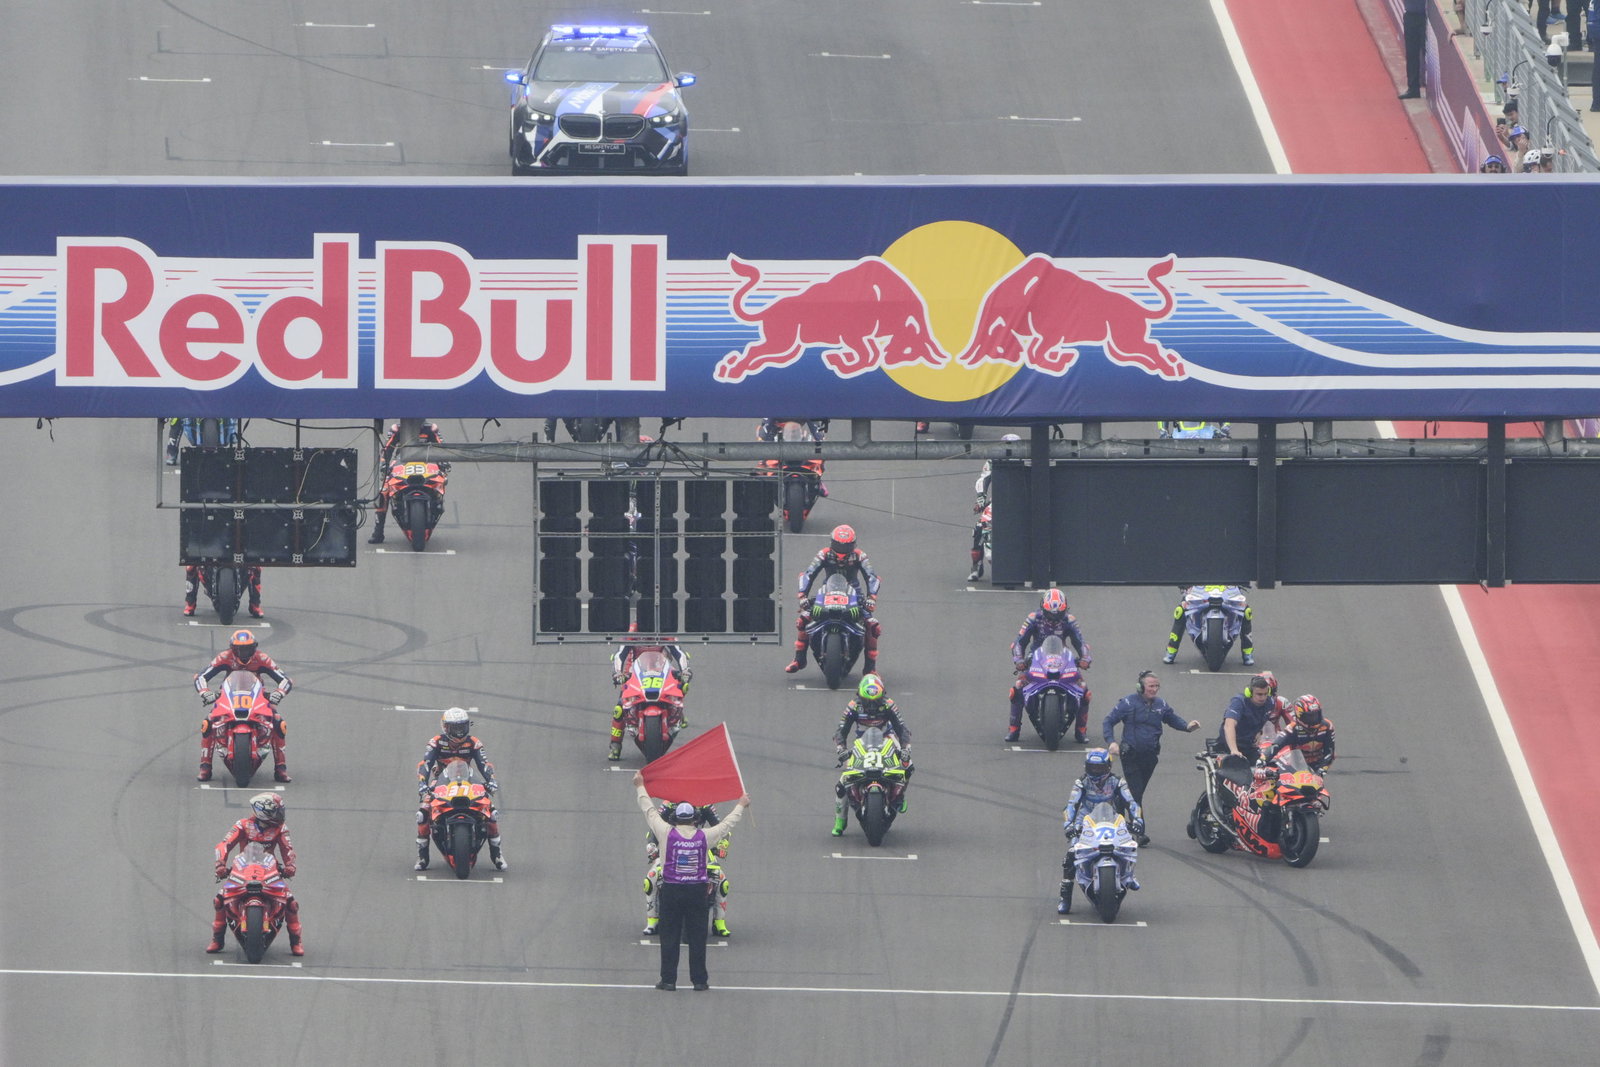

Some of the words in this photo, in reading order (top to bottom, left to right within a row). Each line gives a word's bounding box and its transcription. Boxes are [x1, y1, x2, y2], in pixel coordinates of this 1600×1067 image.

[63, 238, 352, 384] Red
[380, 240, 661, 386] Bull
[405, 464, 426, 475] 33
[641, 676, 664, 689] 36
[232, 695, 253, 709] 10
[863, 751, 884, 768] 21
[448, 784, 469, 797] 37
[1096, 826, 1116, 840] 73
